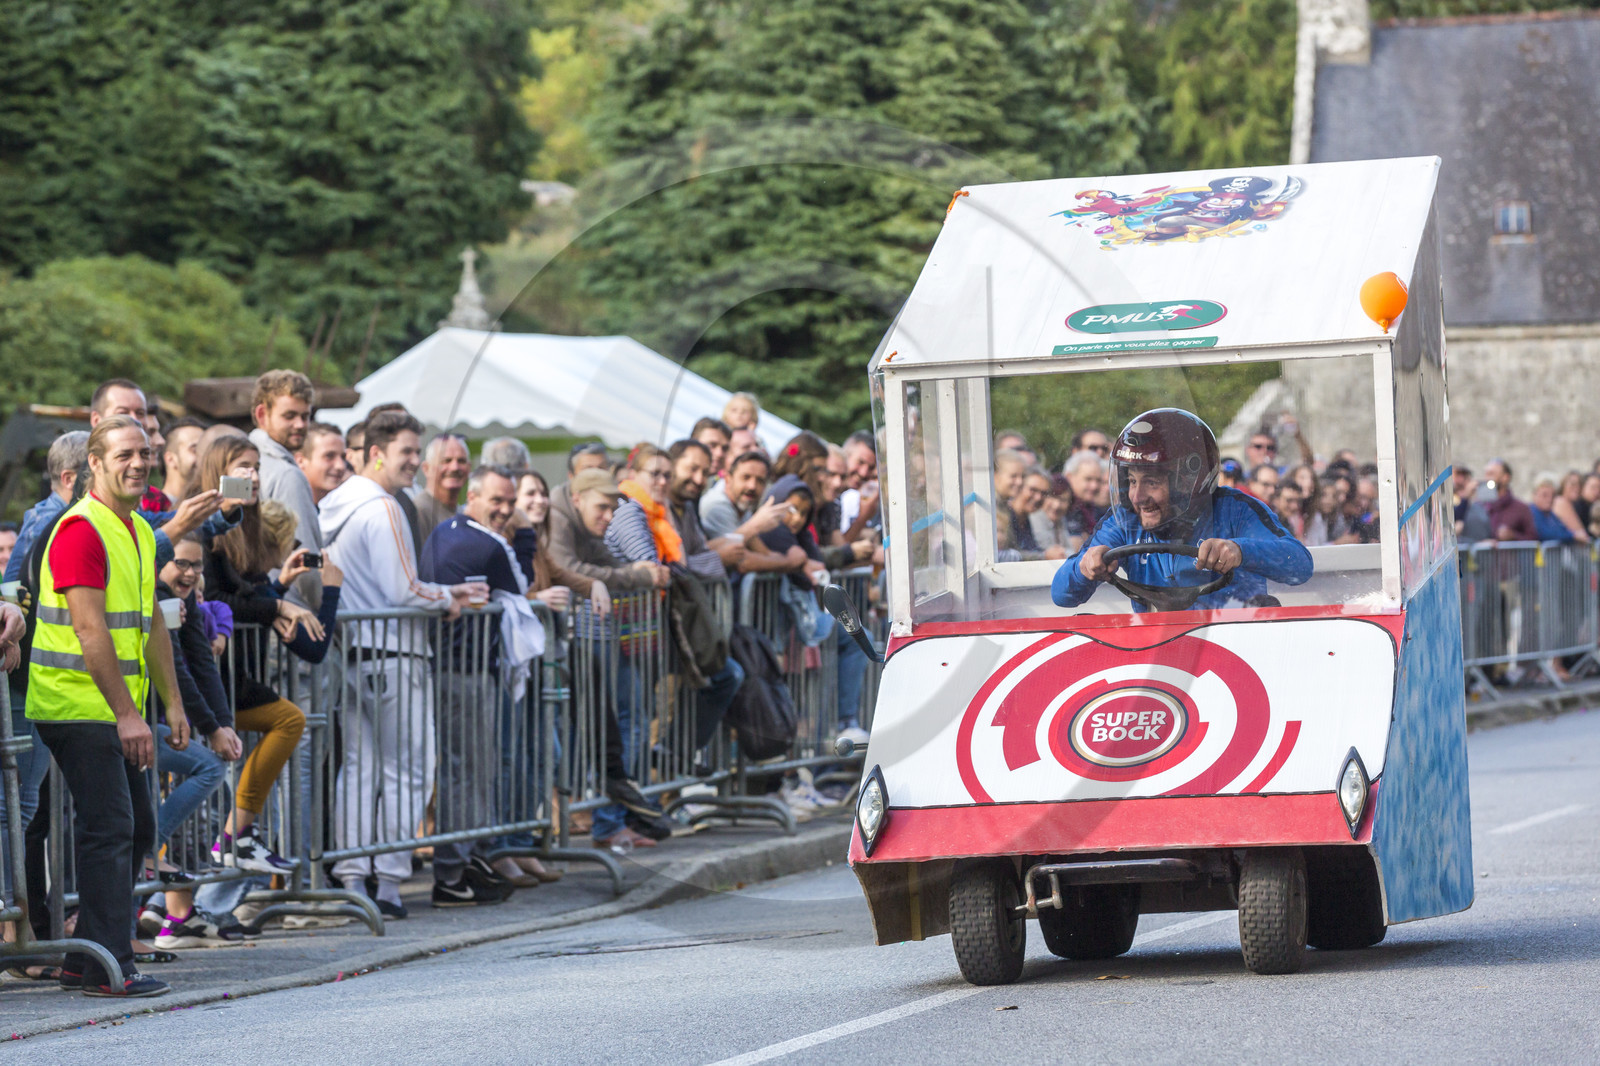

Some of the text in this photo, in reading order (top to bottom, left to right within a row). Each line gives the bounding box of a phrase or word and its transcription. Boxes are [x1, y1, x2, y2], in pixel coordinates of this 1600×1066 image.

[1081, 311, 1157, 326] PMU
[1078, 343, 1103, 352] parie
[1104, 342, 1122, 350] que
[1172, 339, 1206, 347] gagner
[1116, 448, 1143, 460] SHARK
[1090, 710, 1167, 728] SUPER
[1092, 725, 1161, 742] BOCK
